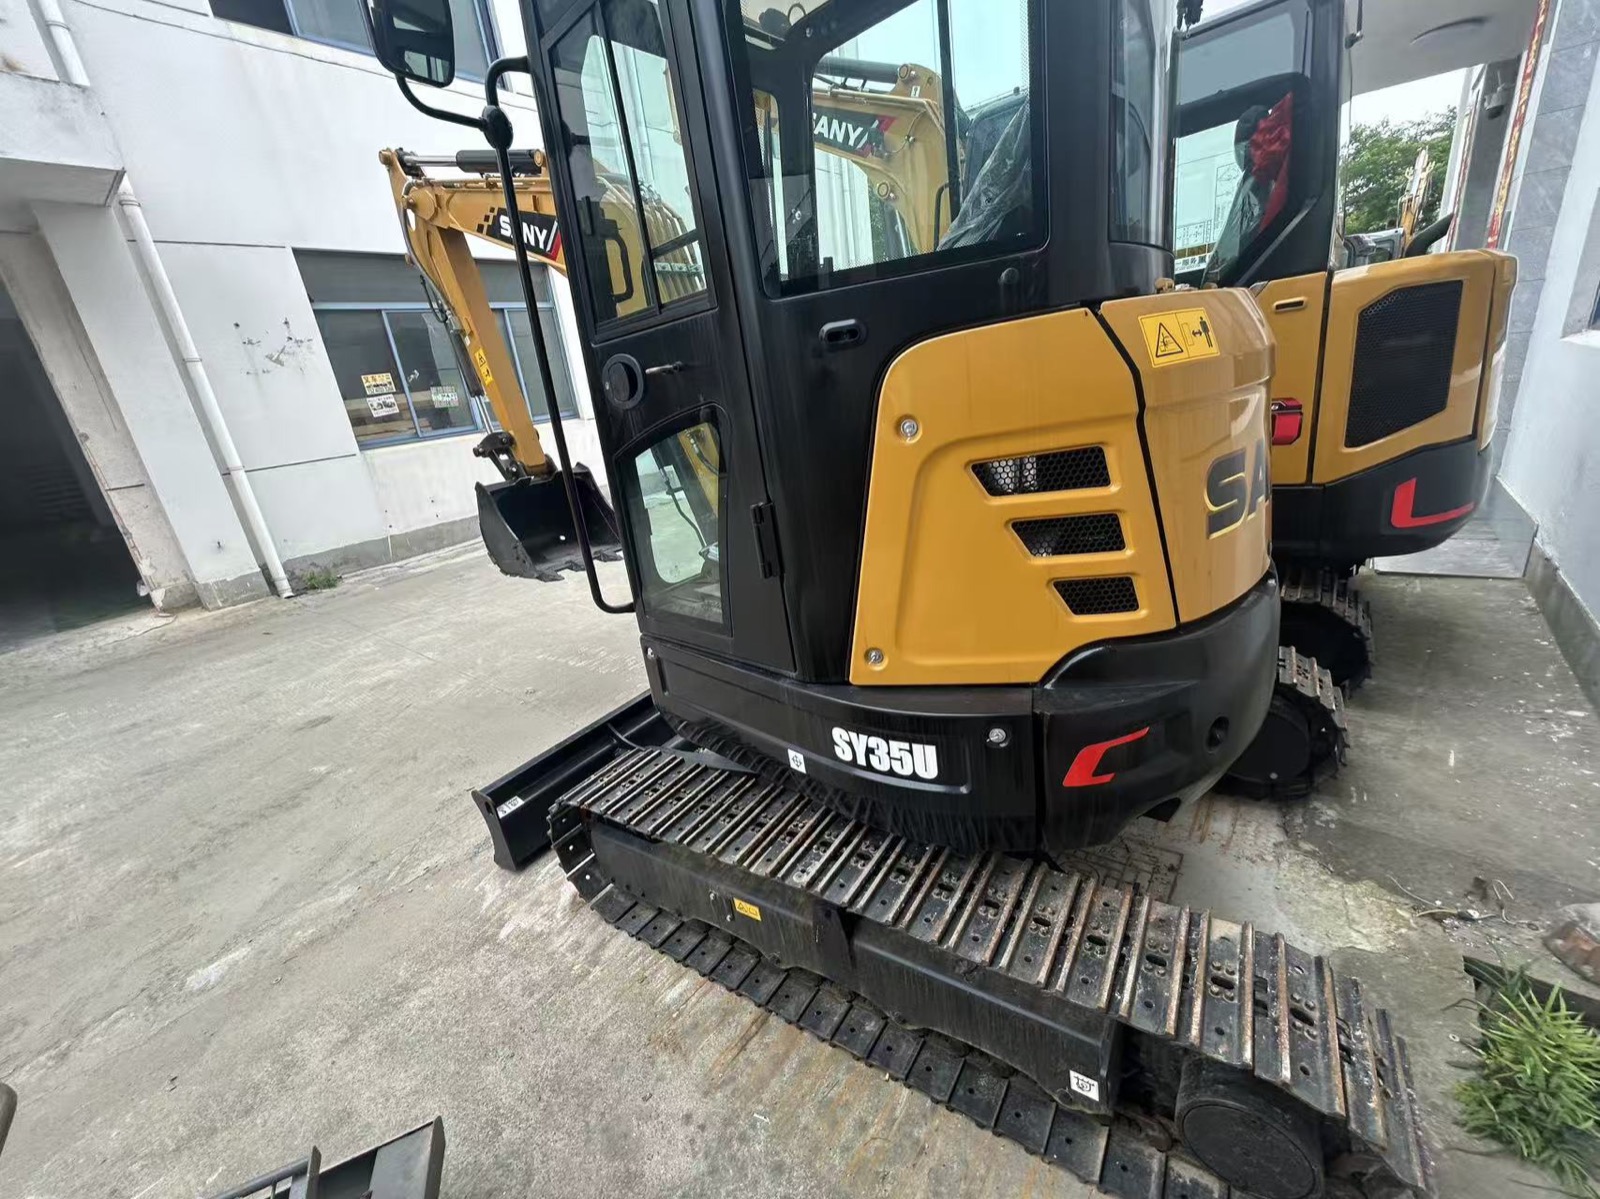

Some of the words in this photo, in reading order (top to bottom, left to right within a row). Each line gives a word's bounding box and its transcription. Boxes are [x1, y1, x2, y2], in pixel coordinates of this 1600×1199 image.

[812, 112, 864, 147] ANY
[499, 214, 548, 250] SNY
[831, 726, 939, 780] SY35U
